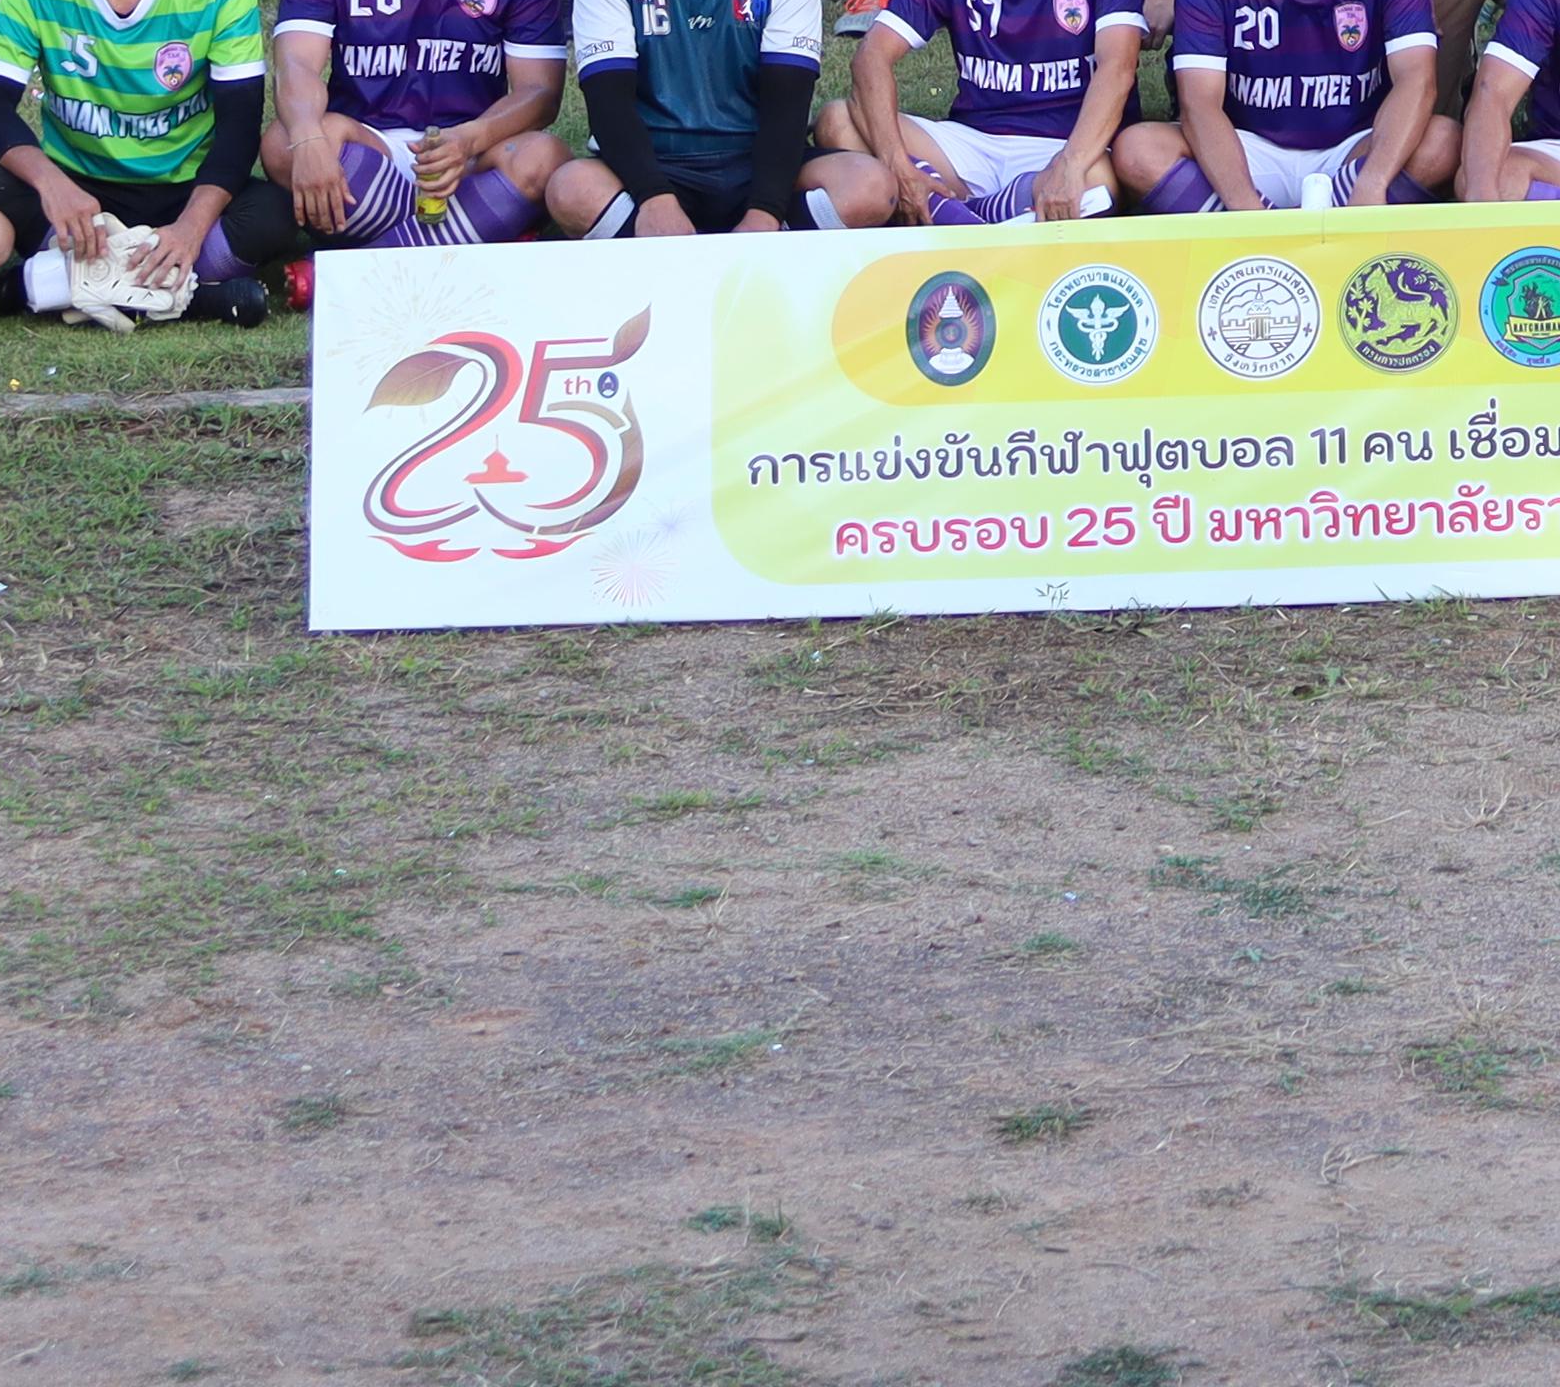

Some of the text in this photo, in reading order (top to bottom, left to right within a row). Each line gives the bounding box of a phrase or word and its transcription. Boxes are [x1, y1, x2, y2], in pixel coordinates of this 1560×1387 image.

[1234, 5, 1280, 50] 20
[344, 44, 407, 78] ANAN
[416, 39, 467, 76] TREE
[1030, 58, 1081, 93] TREE
[1229, 72, 1292, 110] NANA
[1300, 75, 1352, 110] TREE
[564, 375, 592, 396] th
[747, 427, 1295, 488] การแข่งขันกีฬาฟุตบอล
[1310, 427, 1347, 465] 11
[1363, 429, 1434, 464] คน
[836, 513, 1049, 556] ครบรอบ
[1067, 506, 1136, 548] 25
[1152, 494, 1191, 545] ปี
